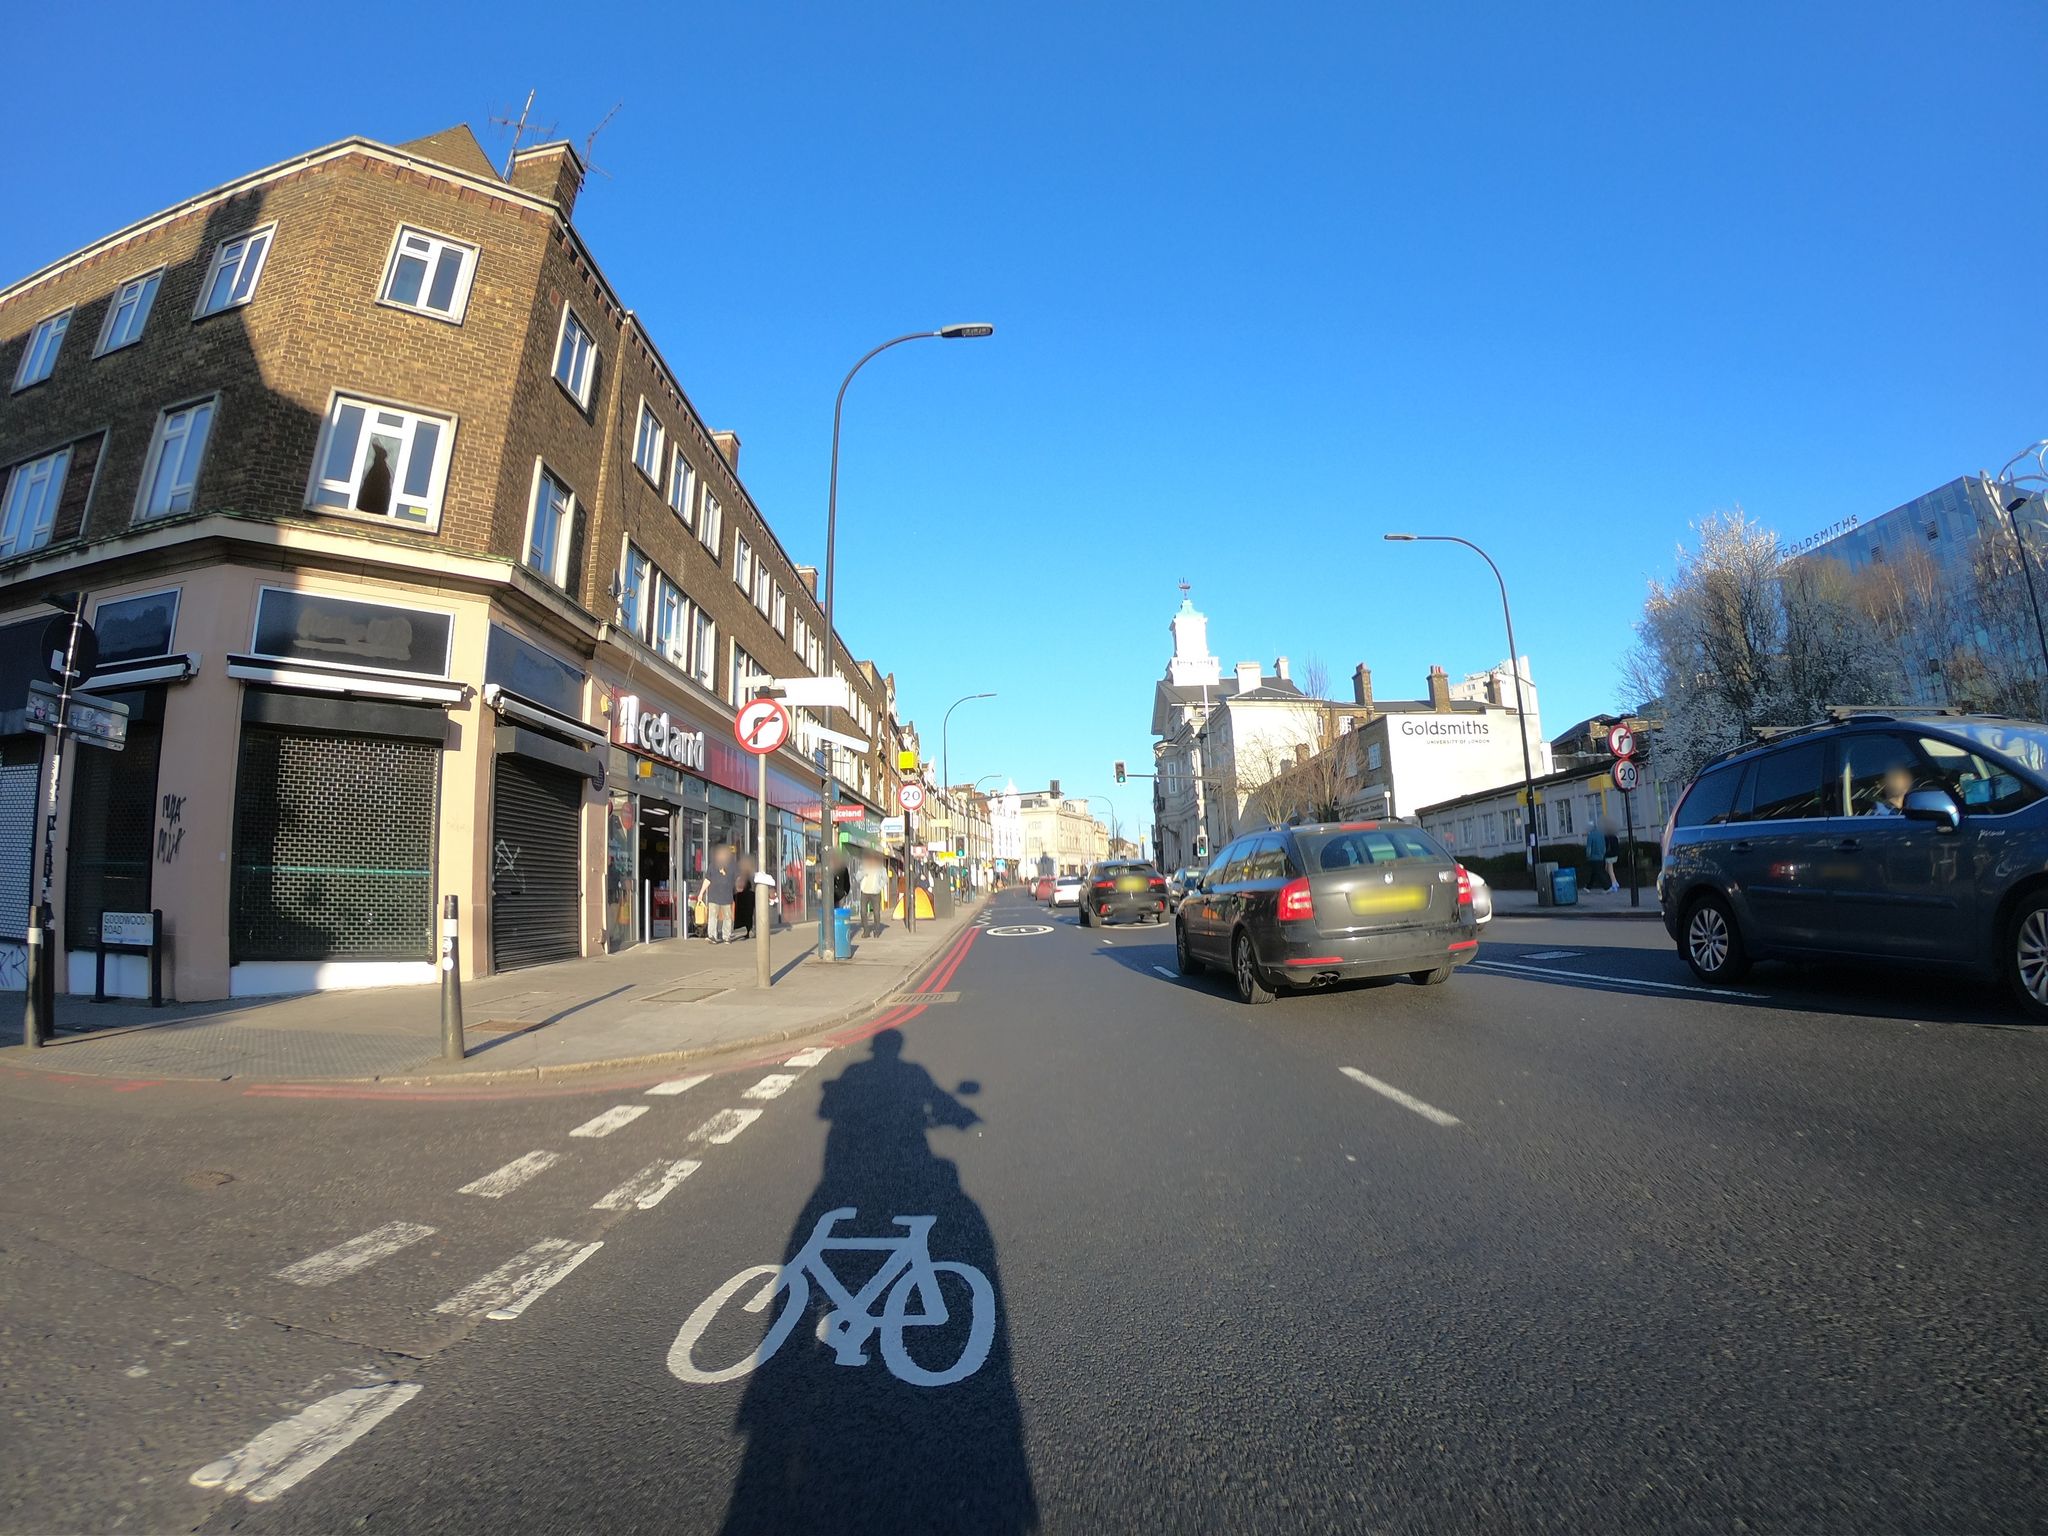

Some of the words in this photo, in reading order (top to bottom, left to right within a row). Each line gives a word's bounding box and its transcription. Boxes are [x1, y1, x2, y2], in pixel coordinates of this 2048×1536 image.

[1782, 514, 1858, 558] GOLDSMITHS
[619, 695, 705, 772] Iceland
[1402, 720, 1489, 735] Goldsmiths
[1619, 767, 1635, 781] 20
[902, 790, 921, 801] 20
[104, 914, 146, 925] GOODWOOD
[104, 925, 122, 935] ROAD
